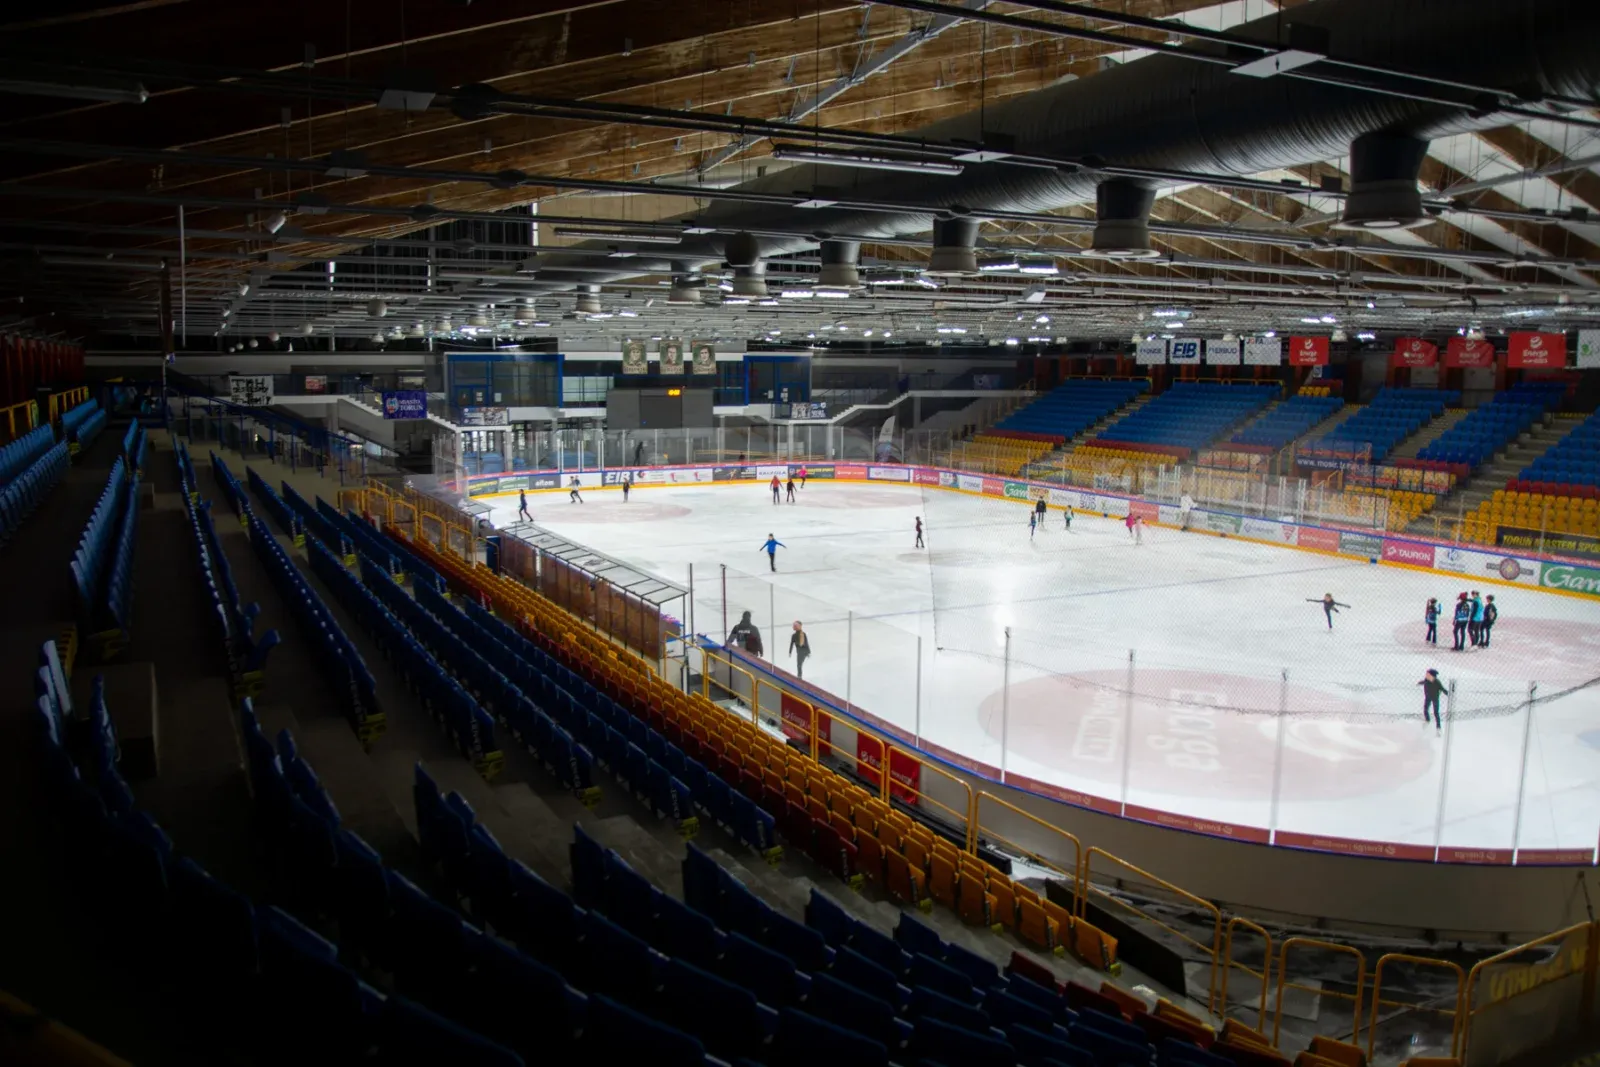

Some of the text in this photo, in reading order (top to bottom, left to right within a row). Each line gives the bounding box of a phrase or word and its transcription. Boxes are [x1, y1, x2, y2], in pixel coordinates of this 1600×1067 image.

[1172, 342, 1198, 359] EIB
[1523, 350, 1548, 358] Energa
[605, 471, 630, 484] EIB
[1535, 538, 1577, 550] MASTEM
[1399, 549, 1431, 561] TAURON
